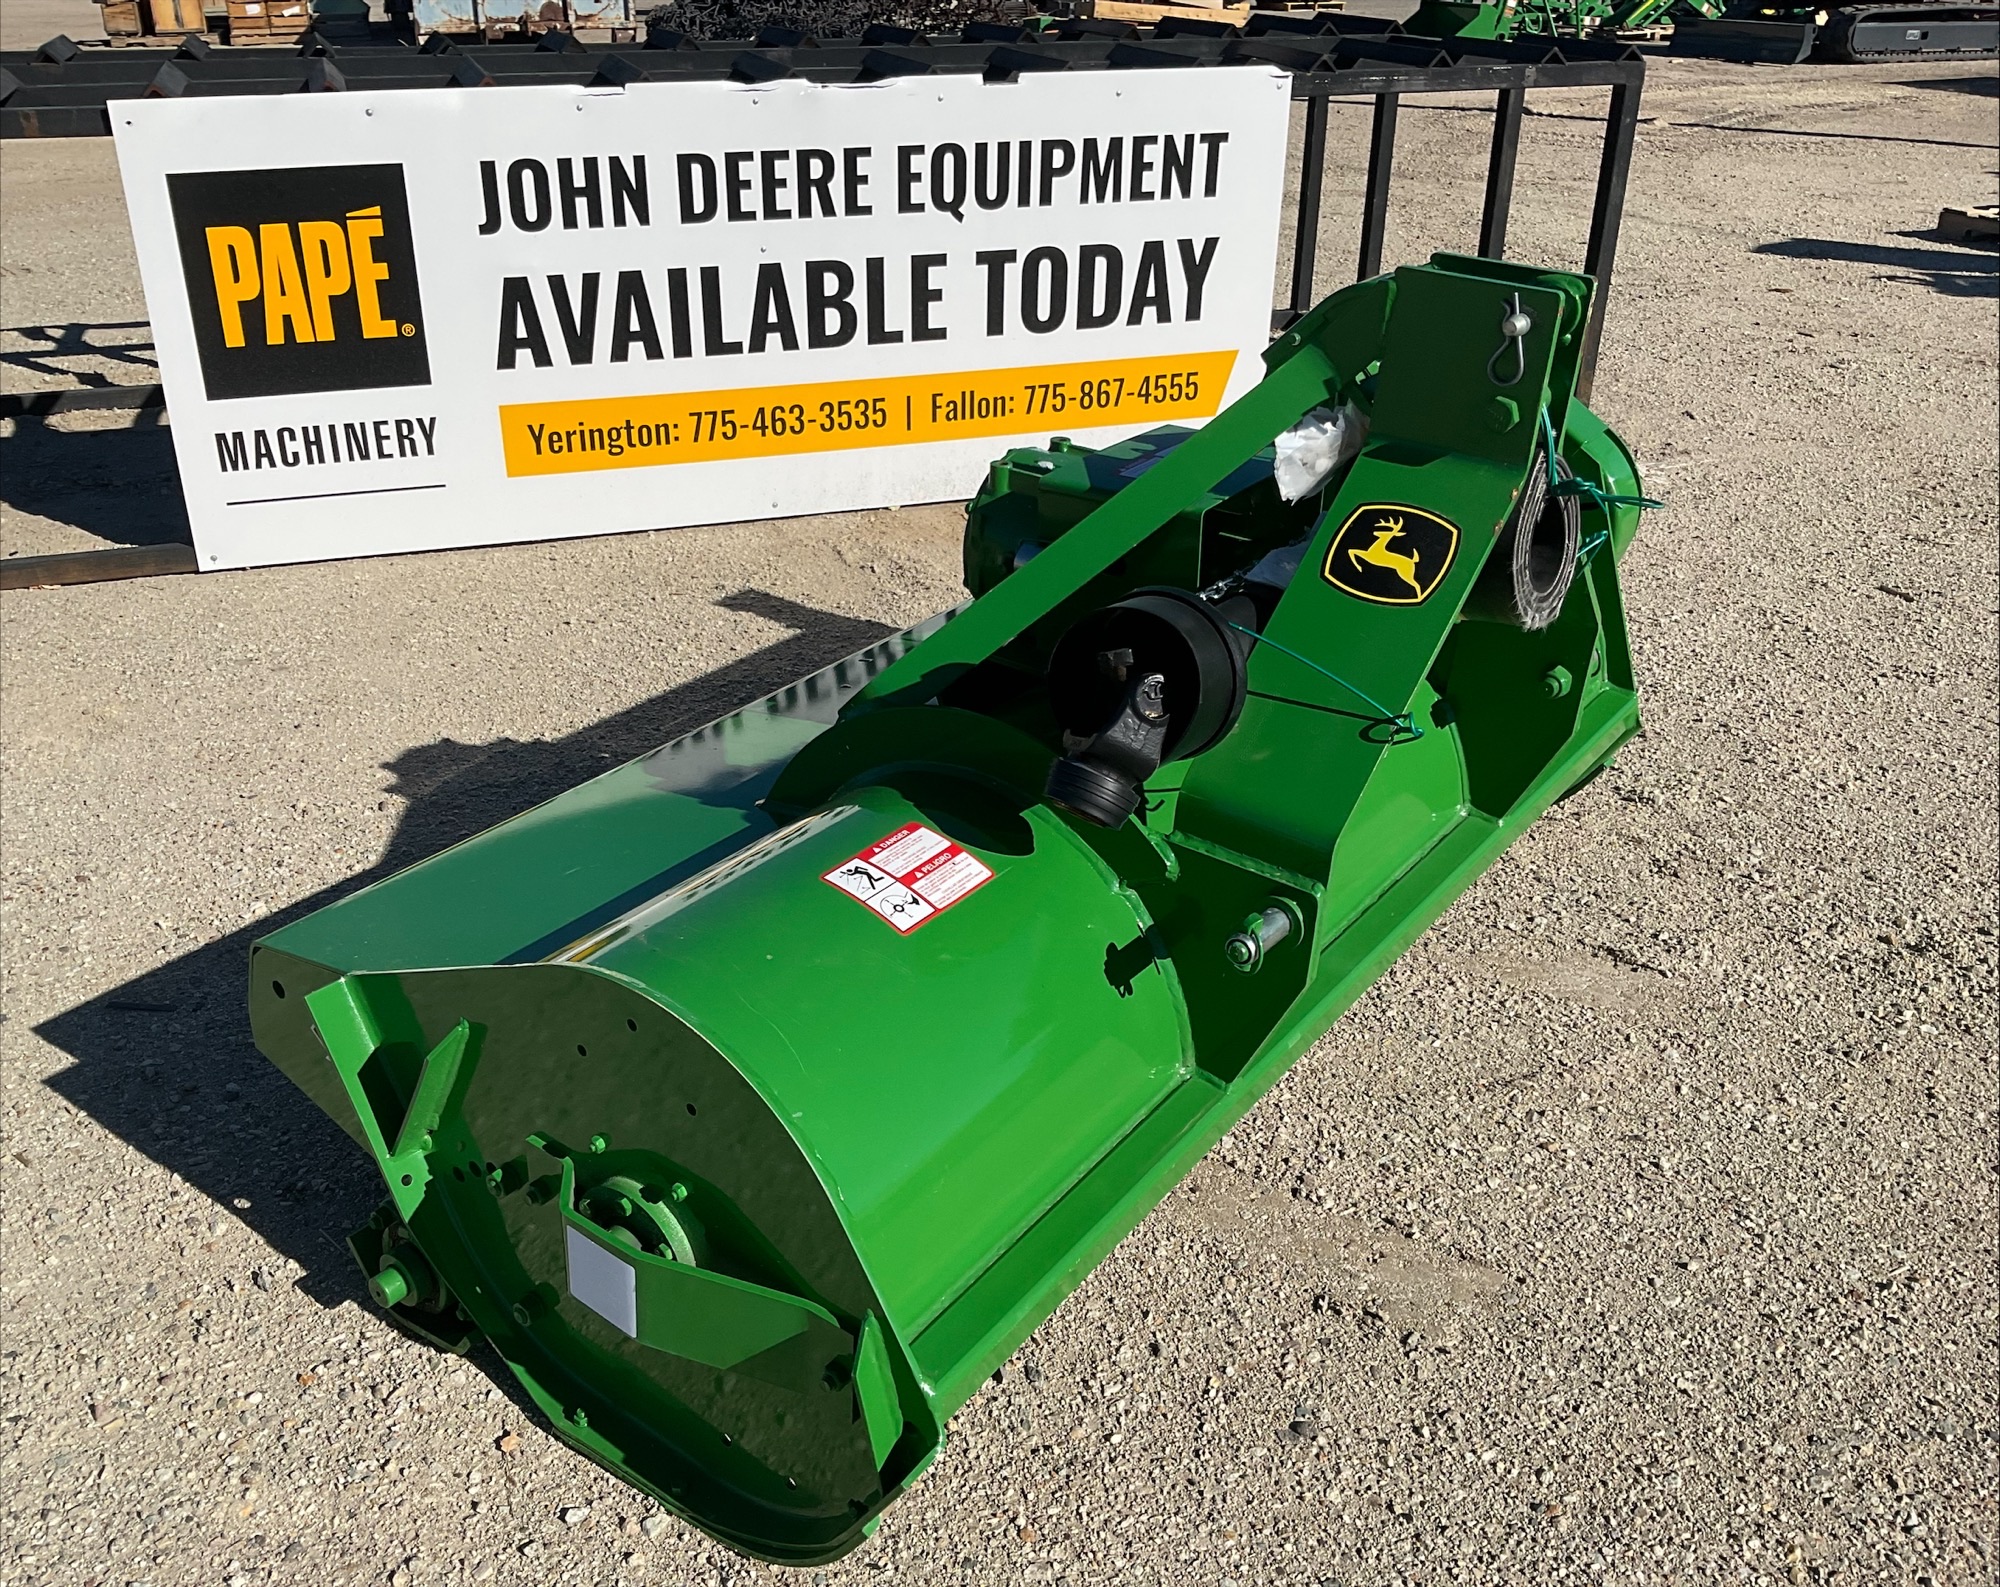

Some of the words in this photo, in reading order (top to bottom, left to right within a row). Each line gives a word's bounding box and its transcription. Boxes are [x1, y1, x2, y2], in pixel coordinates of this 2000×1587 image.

[478, 154, 650, 236] JOHN
[676, 146, 873, 225] DEERE
[897, 132, 1230, 223] EQUIPMENT
[496, 253, 948, 371] AVAILABLE
[975, 236, 1220, 337] TODAY
[214, 416, 438, 474] MACHINERY
[527, 419, 680, 457] Yerington:
[688, 397, 888, 443] 775-463-3535
[931, 390, 1015, 424] Fallon:
[1023, 371, 1200, 416] 775-867-4555
[880, 829, 910, 849] DANGER
[921, 852, 952, 874] PELIGRO
